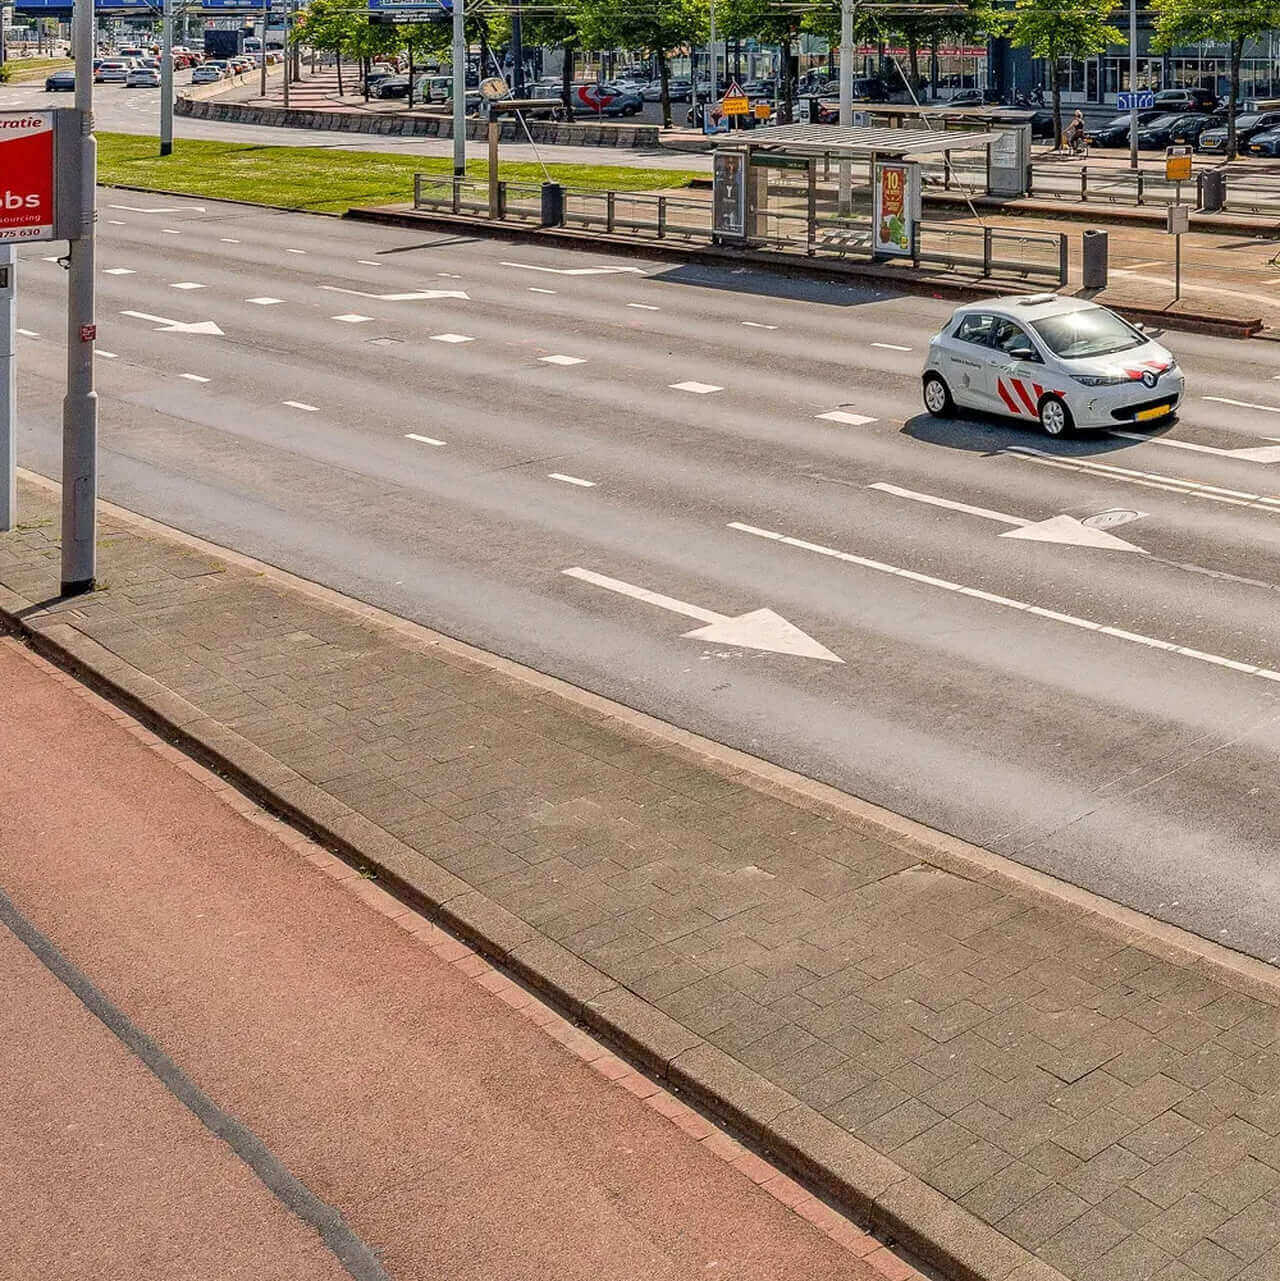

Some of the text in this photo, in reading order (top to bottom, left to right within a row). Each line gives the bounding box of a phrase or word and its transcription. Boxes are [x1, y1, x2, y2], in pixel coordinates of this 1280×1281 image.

[886, 172, 899, 189] 10
[0, 190, 41, 209] bs
[20, 228, 41, 237] 630
